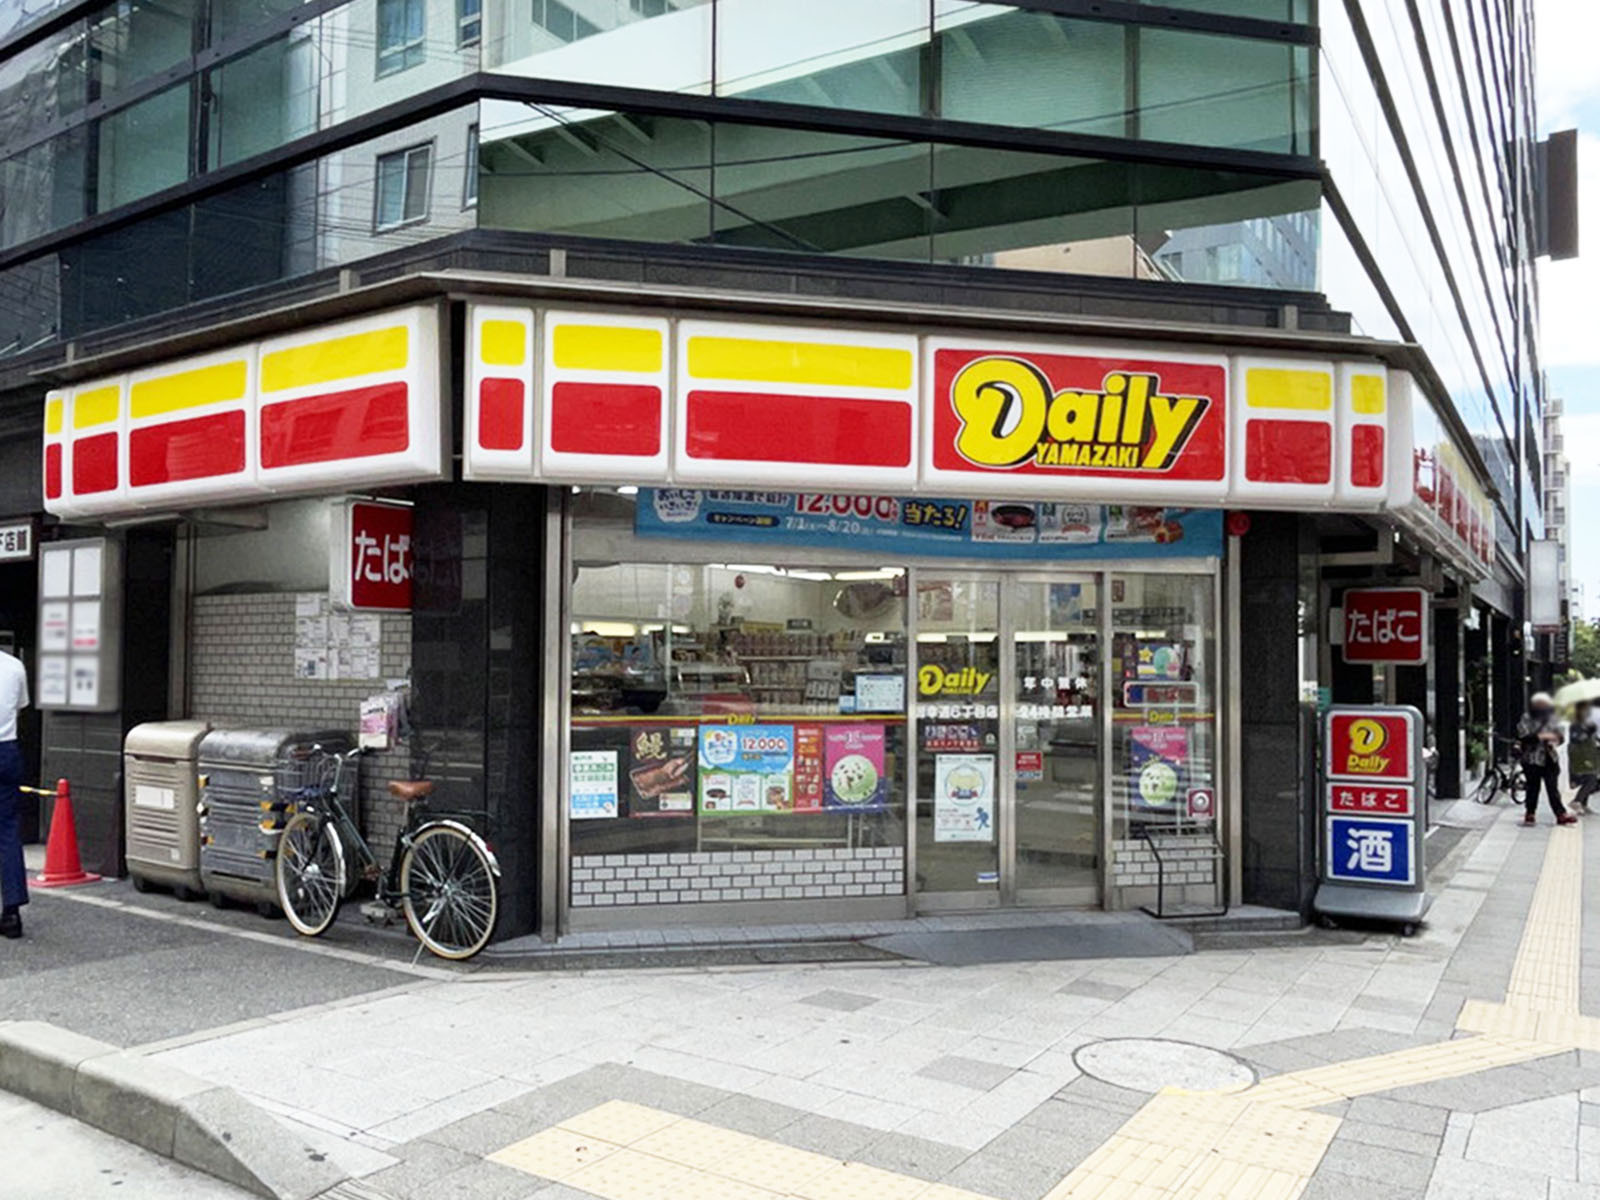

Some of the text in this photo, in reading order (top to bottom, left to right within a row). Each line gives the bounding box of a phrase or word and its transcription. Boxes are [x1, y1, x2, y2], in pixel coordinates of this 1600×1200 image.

[951, 356, 1211, 470] Daily
[1036, 442, 1140, 467] YAMAZAKI
[354, 530, 410, 584] たば
[1348, 609, 1419, 643] たばこ
[918, 664, 990, 695] Daily
[1347, 755, 1391, 772] Daily
[1340, 791, 1400, 808] たばこ
[1347, 828, 1393, 872] 酒
